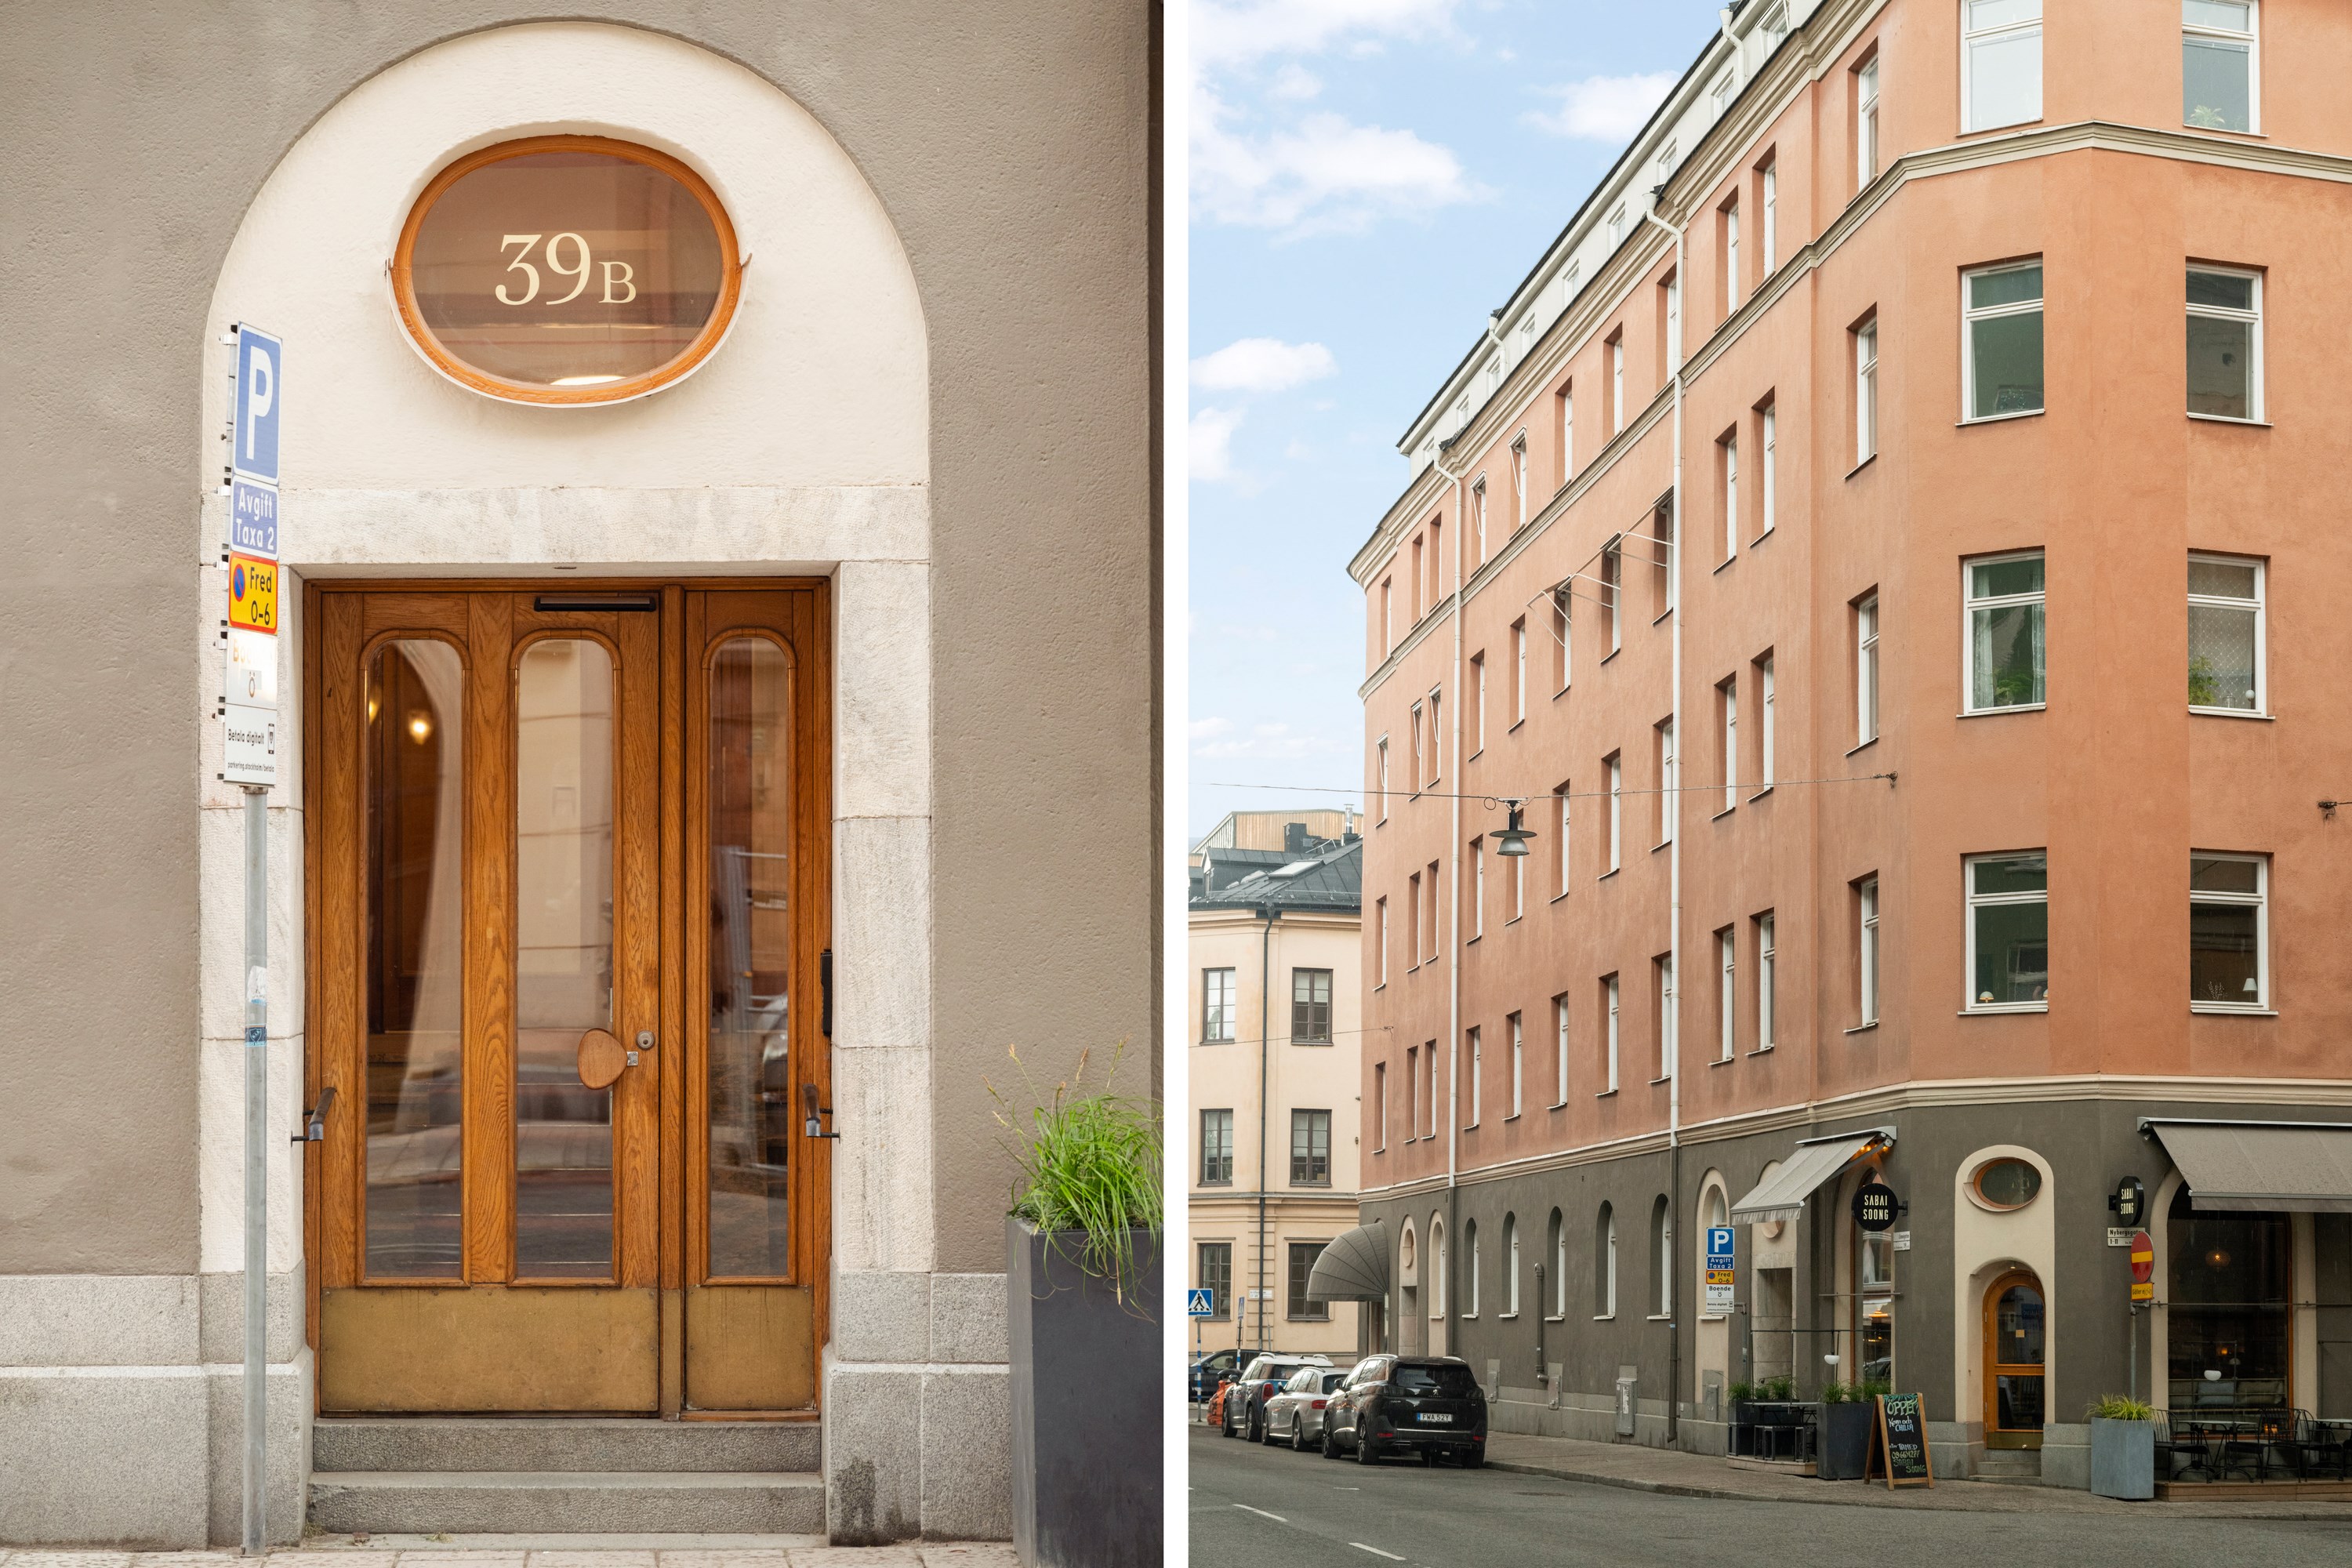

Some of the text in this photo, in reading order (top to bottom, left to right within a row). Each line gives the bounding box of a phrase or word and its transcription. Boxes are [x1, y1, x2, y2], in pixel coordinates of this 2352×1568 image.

[246, 345, 274, 460] P
[238, 487, 273, 521] Avgift
[236, 518, 274, 550] Taxa 2
[250, 566, 272, 593] Fred
[251, 600, 270, 626] 0-6
[249, 671, 256, 698] Ö
[228, 728, 264, 746] Betala digitalt
[1864, 1195, 1888, 1206] SABAI
[2121, 1188, 2133, 1200] SABAI
[1863, 1209, 1889, 1220] SOONG
[2120, 1203, 2133, 1214] SOONG
[1715, 1231, 1730, 1253] P
[1886, 1398, 1918, 1416] ÖPPET
[1888, 1416, 1912, 1427] Kom och
